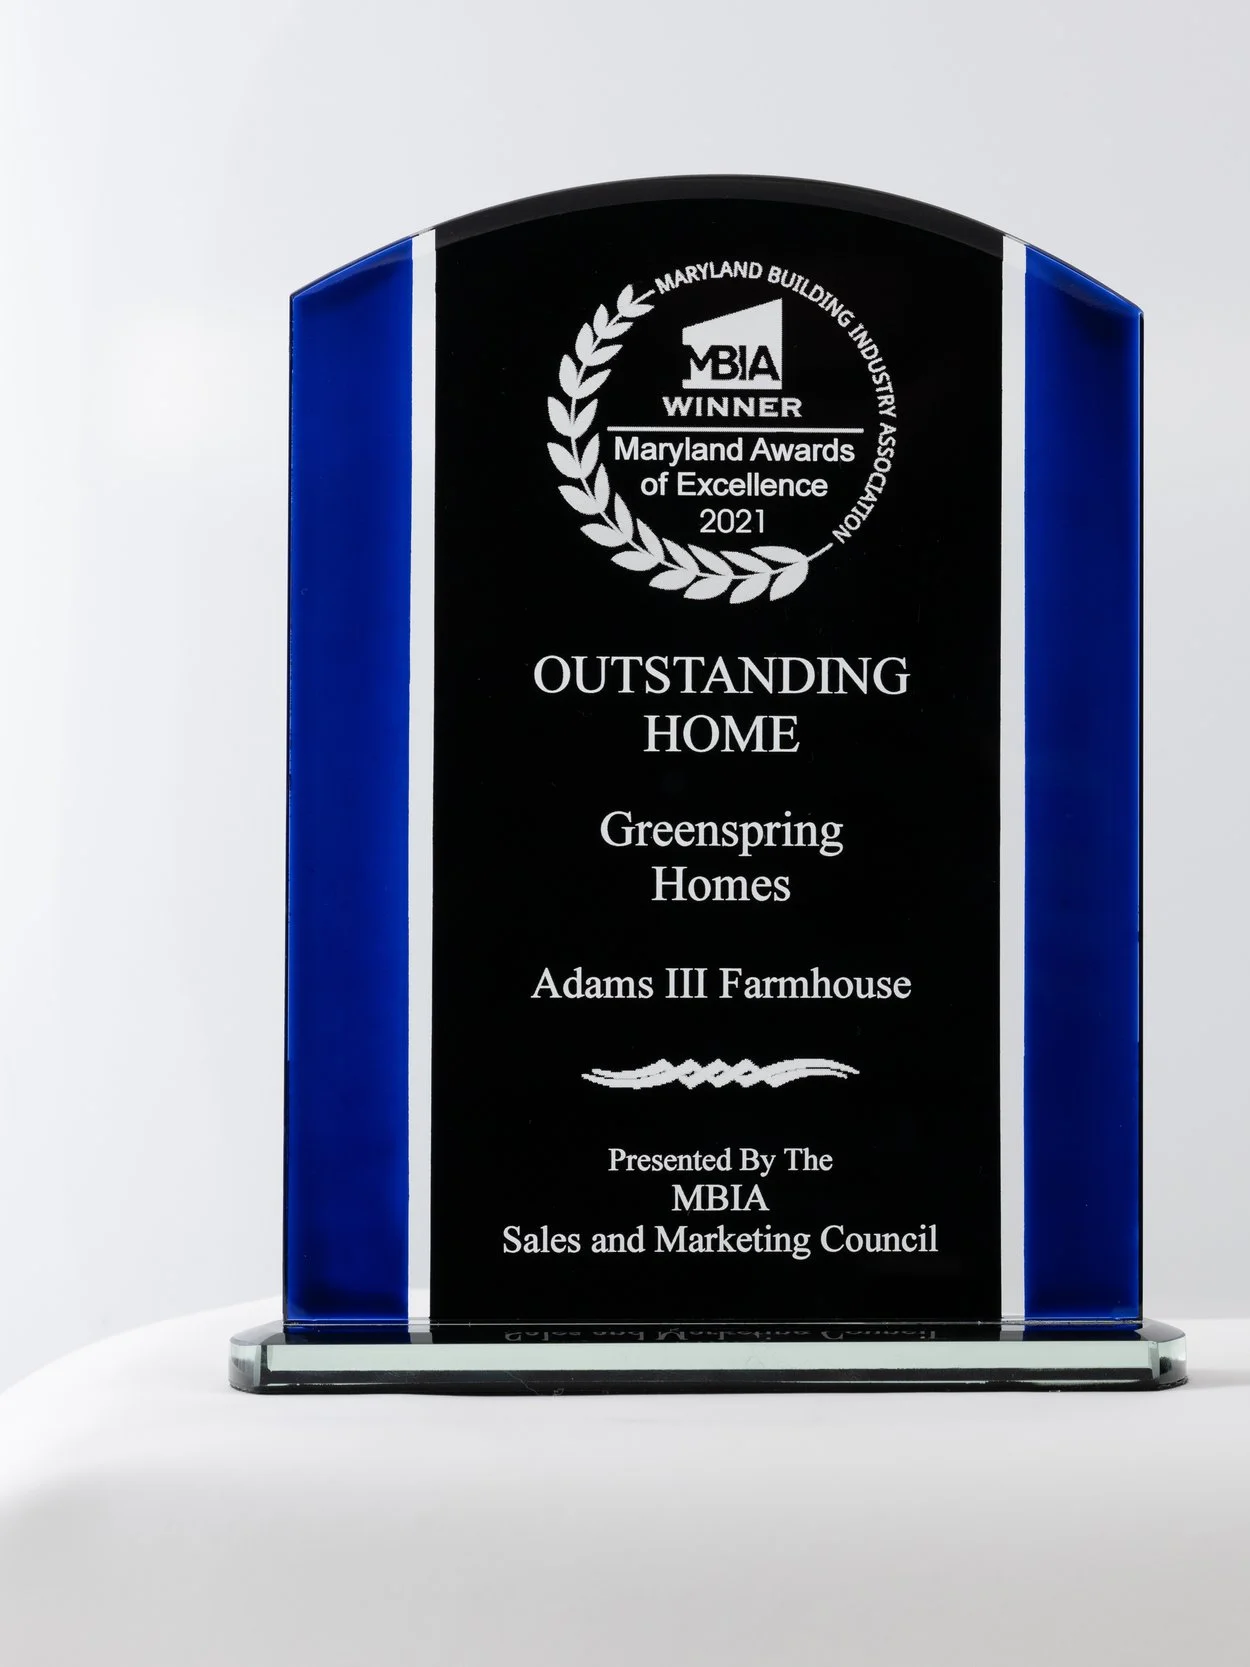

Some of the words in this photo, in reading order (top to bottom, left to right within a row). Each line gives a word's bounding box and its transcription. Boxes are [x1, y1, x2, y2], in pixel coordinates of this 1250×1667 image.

[655, 262, 762, 294] MARYLAND
[767, 266, 853, 328] BUILDING
[683, 345, 780, 381] MBIA
[848, 322, 897, 419] INDUSTRY
[662, 397, 802, 417] WINNER
[615, 436, 743, 467] Maryland
[750, 437, 855, 462] Awards
[640, 472, 669, 496] of
[677, 473, 828, 497] Excellence
[832, 422, 897, 544] ASSOCIATION
[700, 509, 764, 533] 2021
[534, 655, 910, 695] OUTSTANDING
[644, 715, 800, 752] HOME
[601, 811, 843, 856] Greenspring
[652, 866, 790, 901] Homes
[531, 967, 653, 998] Adams
[666, 968, 707, 998] III
[719, 967, 911, 999] Farmhouse
[608, 1148, 732, 1171] Presented
[739, 1148, 776, 1177] By
[784, 1147, 833, 1171] The
[672, 1184, 770, 1211] MBIA
[503, 1225, 581, 1253] Sales
[592, 1225, 645, 1253] and
[655, 1225, 811, 1260] Marketing
[821, 1224, 938, 1252] Council
